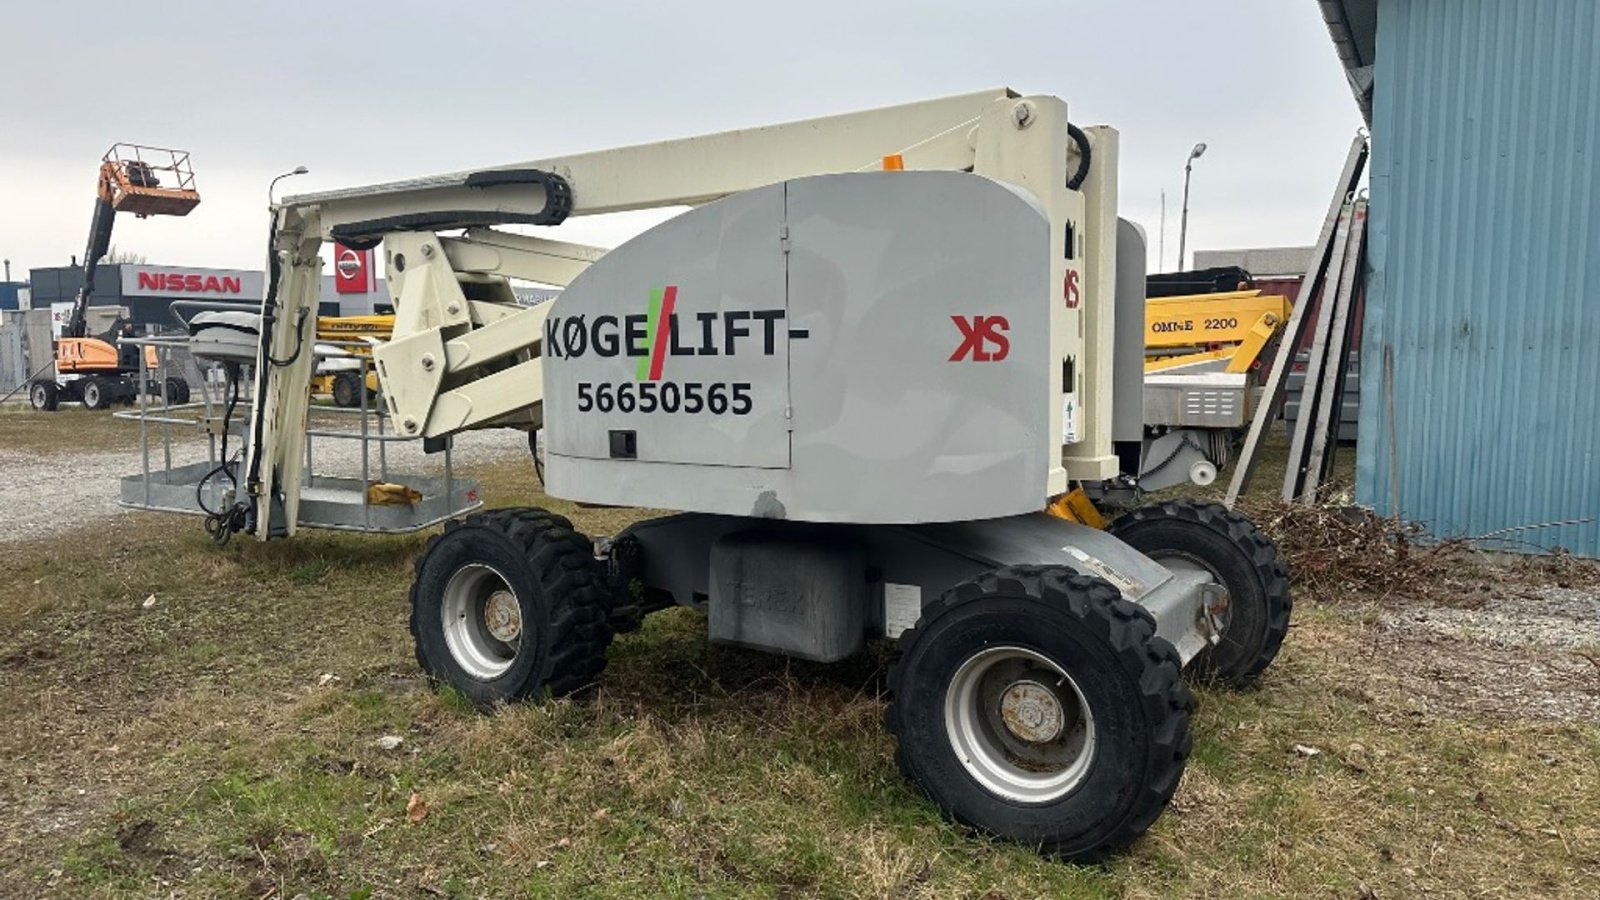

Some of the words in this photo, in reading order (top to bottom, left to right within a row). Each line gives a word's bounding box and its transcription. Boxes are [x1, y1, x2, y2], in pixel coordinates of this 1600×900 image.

[138, 271, 241, 293] NISSAN
[546, 313, 650, 361] KØGE
[1204, 317, 1238, 330] 2200
[577, 381, 753, 416] 56650565
